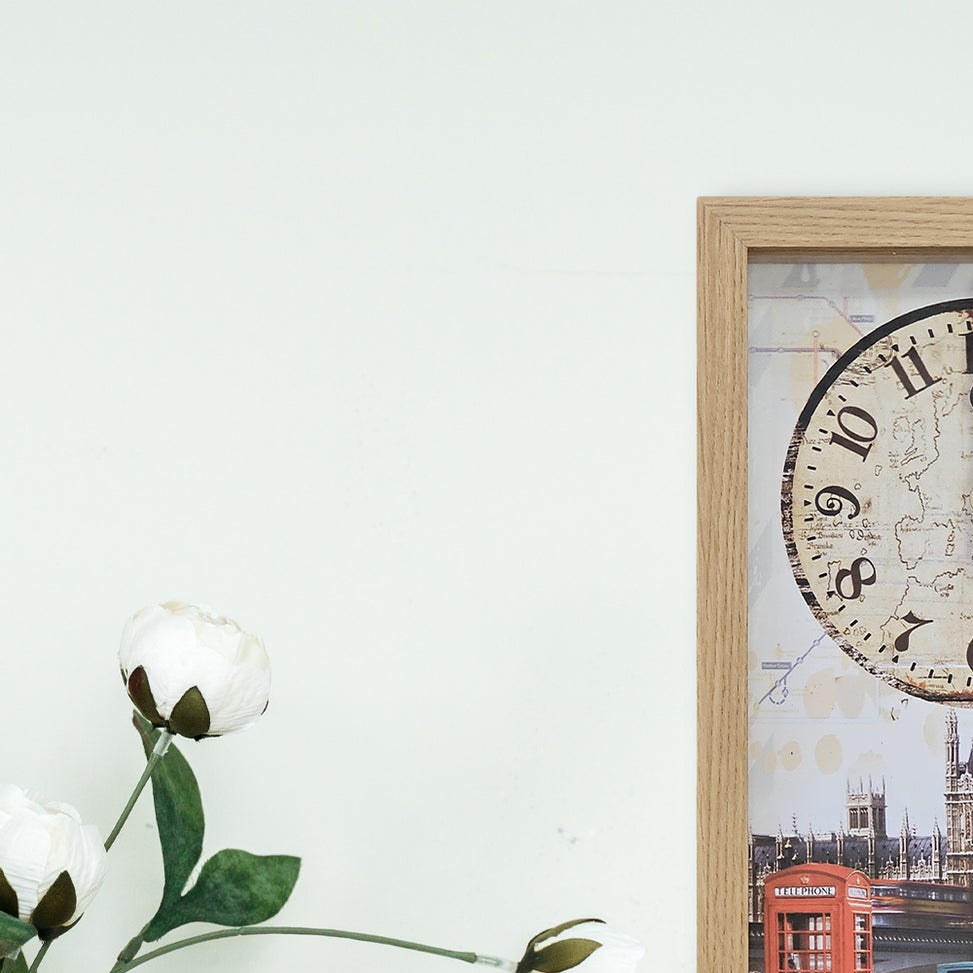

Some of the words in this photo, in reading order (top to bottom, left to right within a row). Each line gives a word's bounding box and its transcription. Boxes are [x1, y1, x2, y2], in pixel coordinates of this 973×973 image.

[884, 346, 942, 399] 11
[829, 406, 878, 462] 10
[815, 486, 860, 519] 9
[836, 557, 876, 600] 8
[895, 611, 933, 652] 7
[776, 887, 835, 896] TELEPHONE
